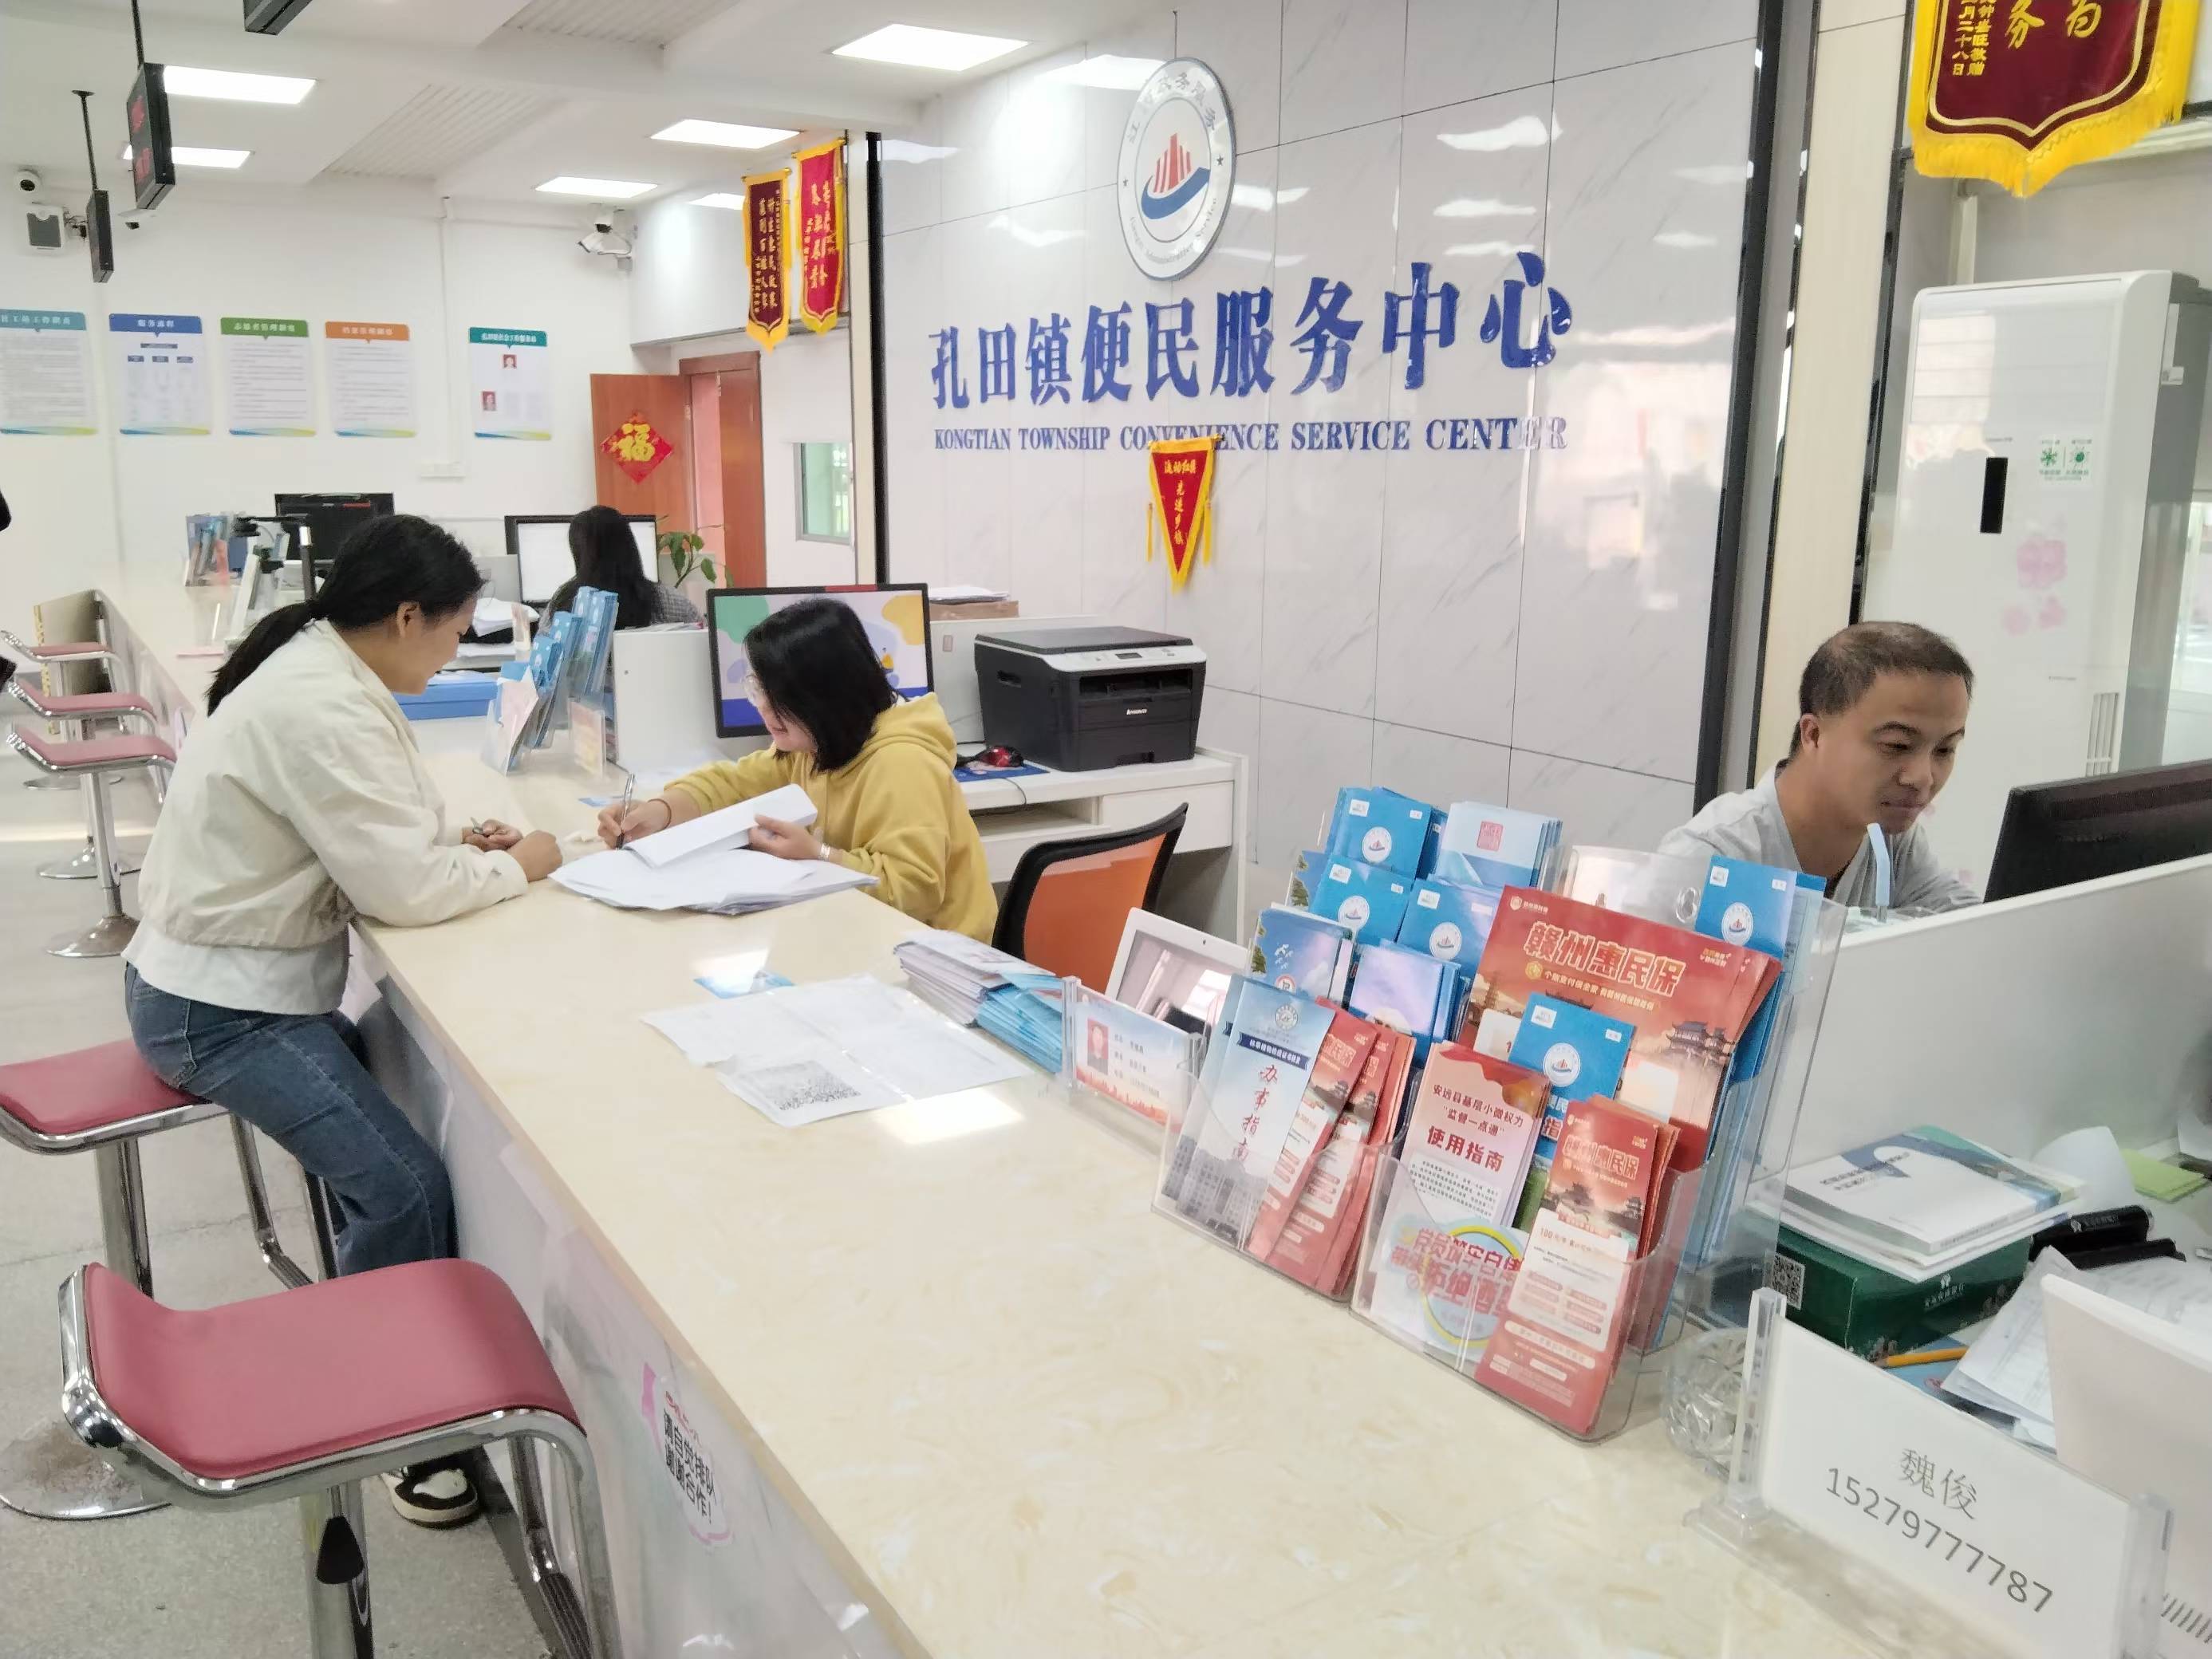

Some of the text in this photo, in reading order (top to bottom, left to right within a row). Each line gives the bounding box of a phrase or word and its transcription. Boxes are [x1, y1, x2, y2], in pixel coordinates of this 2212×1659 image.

[1952, 0, 1979, 76] 月二十八日
[929, 250, 1573, 409] 孔田镇便民服务中心
[935, 428, 1011, 451] KONGTIAN
[1018, 427, 1110, 451] TOWNSHIP
[1291, 420, 1410, 451] SERVICE
[1425, 417, 1568, 451] CENTER
[1524, 920, 1686, 998] 赣州惠民保
[1232, 1064, 1278, 1162] 办事指南
[1432, 1083, 1524, 1129] 安远县基层小微权力
[1426, 1125, 1505, 1174] 使用指南
[1899, 1447, 1980, 1520] 魏俊
[1825, 1466, 2055, 1614] 15279777787
